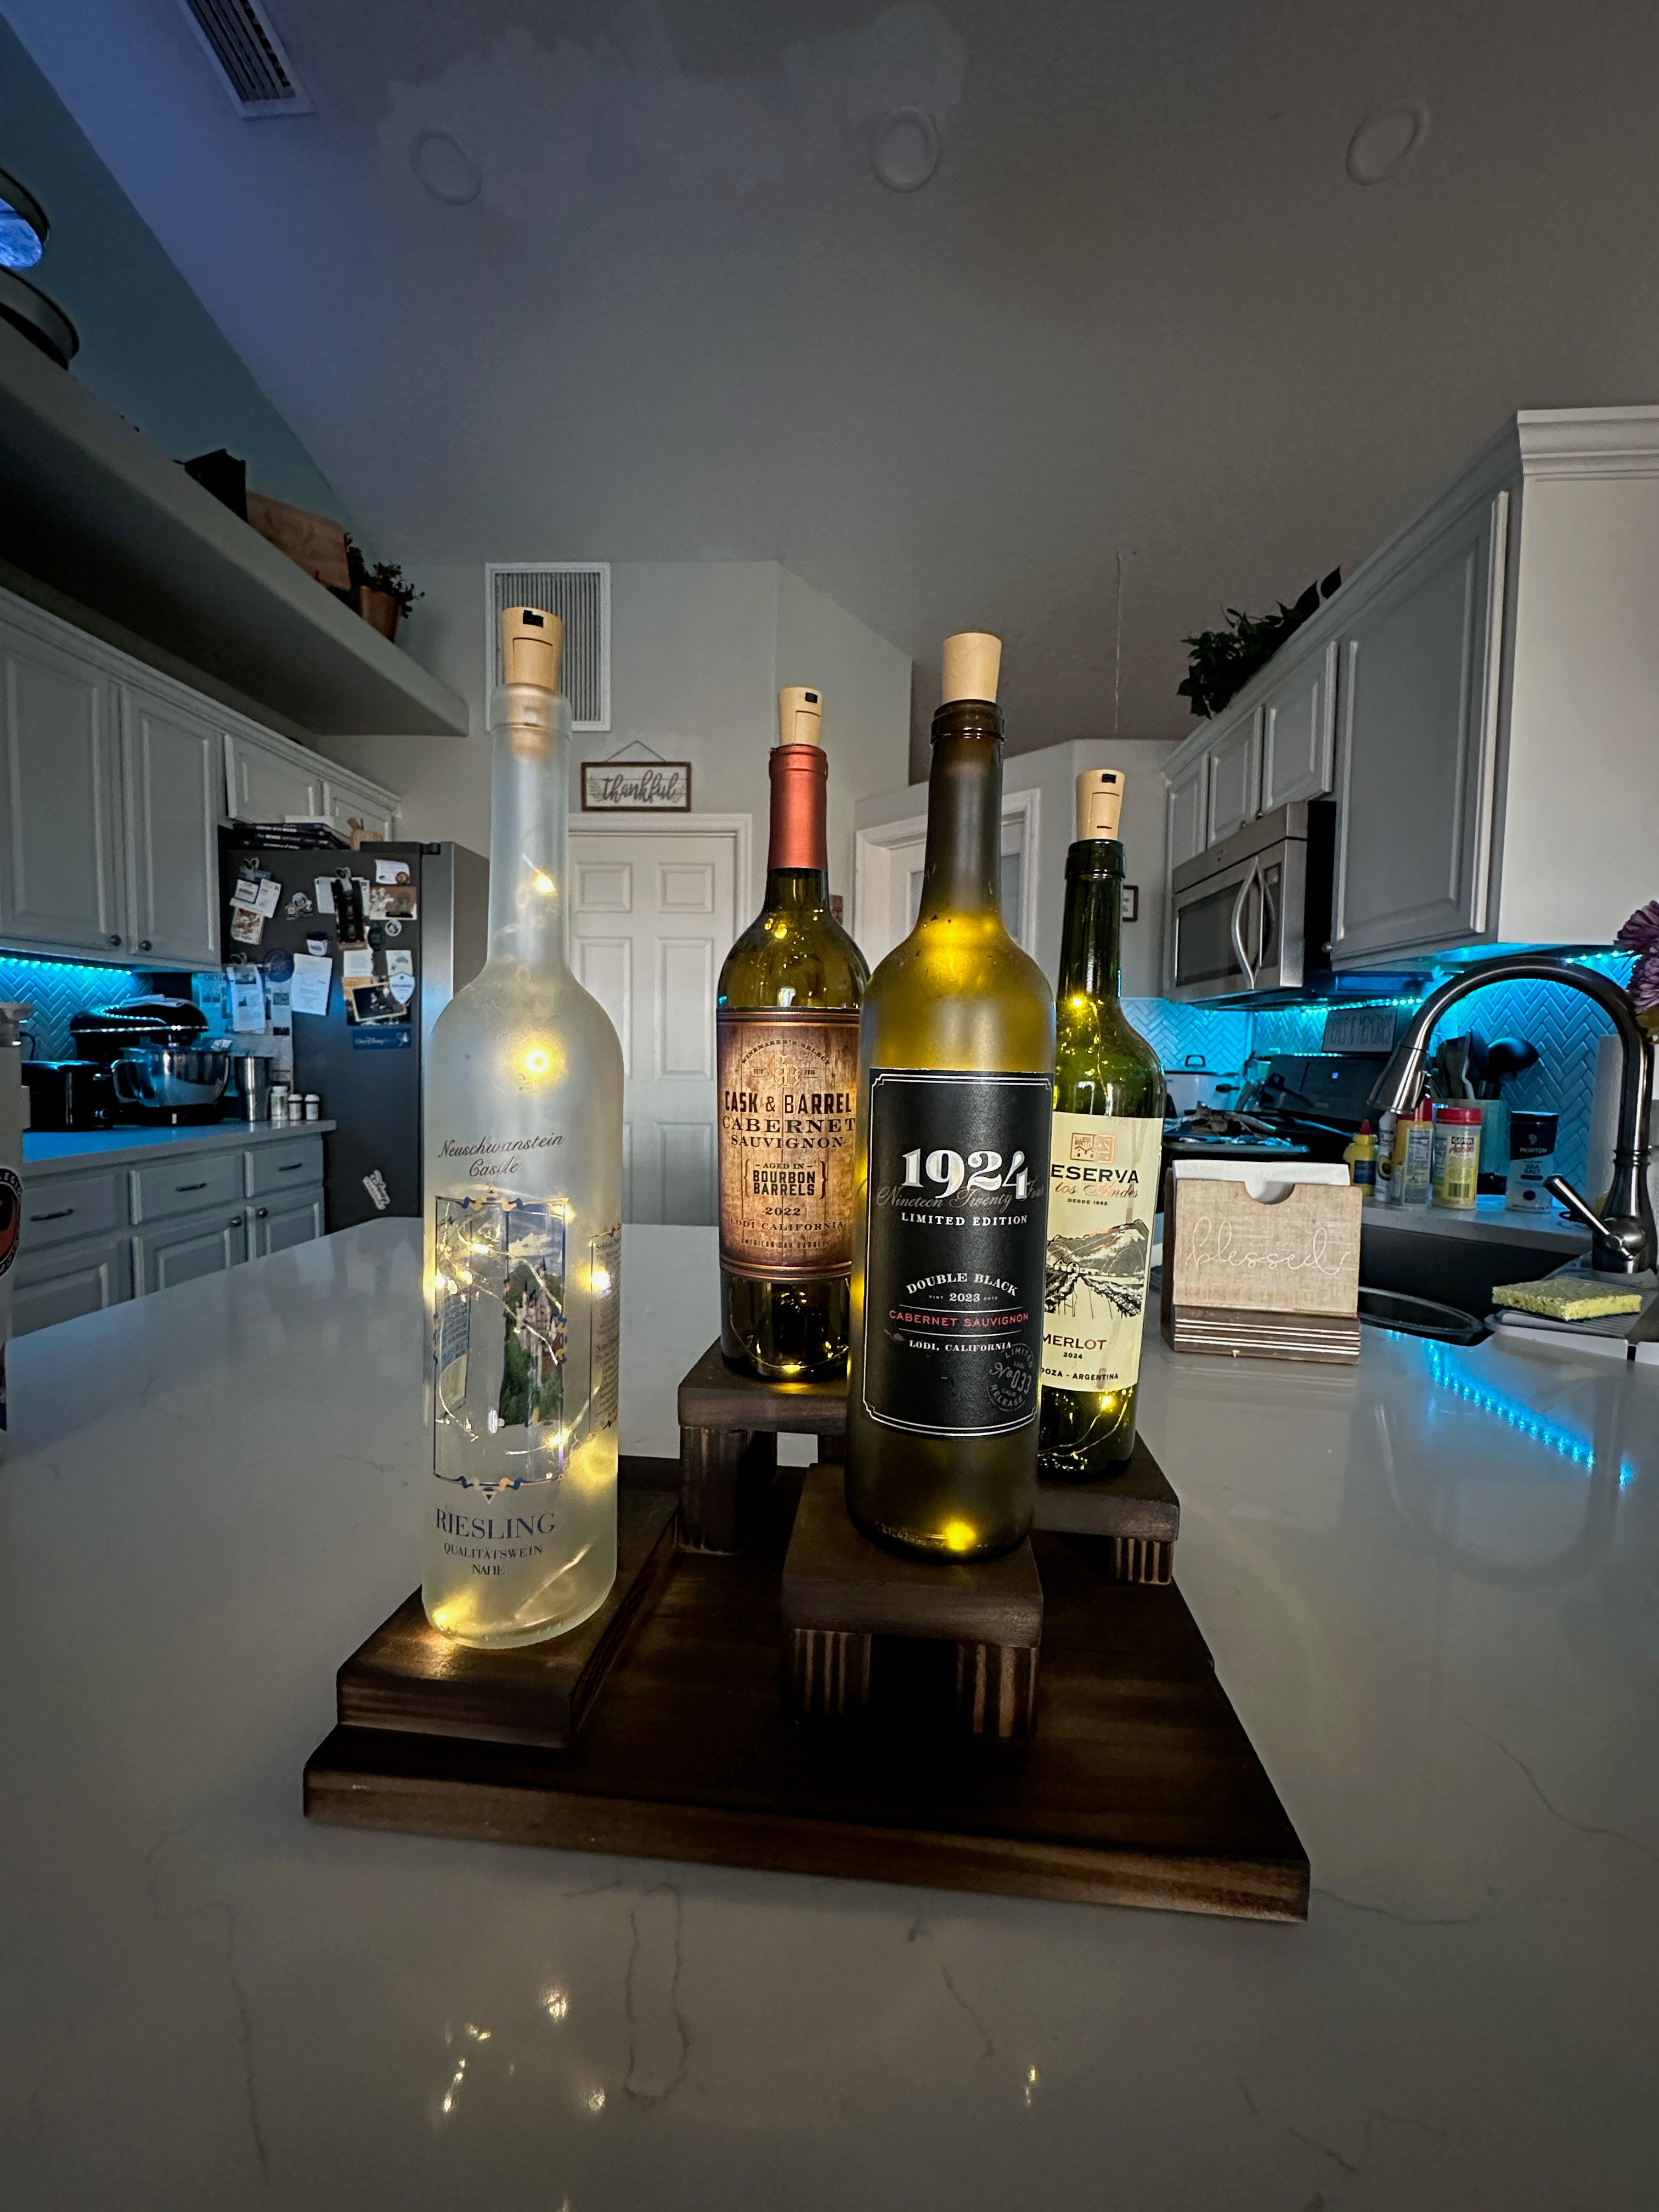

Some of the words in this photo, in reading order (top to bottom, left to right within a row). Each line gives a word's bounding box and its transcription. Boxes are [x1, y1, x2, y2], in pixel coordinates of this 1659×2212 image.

[602, 770, 679, 804] thankful
[741, 1039, 797, 1064] WINEMAKER'S
[801, 1043, 830, 1065] SELECT
[725, 1091, 758, 1113] CASK
[766, 1096, 775, 1112] &
[785, 1093, 851, 1114] BARREL
[723, 1115, 855, 1133] CABERNET
[438, 1132, 565, 1158] Neuschwanstein
[731, 1135, 843, 1149] SAUVIGNON
[469, 1155, 520, 1177] Castle
[901, 1148, 1029, 1199] 1924
[1051, 1164, 1139, 1183] ESERVA
[753, 1170, 815, 1183] BOURBON
[754, 1182, 815, 1195] BARRELS
[1055, 1181, 1076, 1194] los
[1084, 1180, 1138, 1198] Andes
[876, 1186, 943, 1207] Nineteen
[950, 1186, 1014, 1213] Twenty
[765, 1207, 801, 1216] 2022
[901, 1212, 964, 1226] LIMITED
[972, 1215, 1028, 1226] EDITION
[730, 1217, 755, 1228] LODI
[761, 1221, 844, 1231] CALIFORNIA
[741, 1238, 774, 1248] AMERICAN
[1185, 1216, 1351, 1276] blessed
[906, 1273, 967, 1294] DOUBLE
[974, 1273, 1018, 1296] BLACK
[949, 1293, 980, 1302] 2023
[889, 1310, 958, 1327] CABERNET
[964, 1312, 1029, 1327] SAUVIGNON
[909, 1340, 940, 1351] LODI,
[945, 1341, 1011, 1352] CALIFORNIA
[1043, 1334, 1107, 1350] MERLOT
[1005, 1347, 1032, 1368] LIMITED
[1011, 1370, 1032, 1394] 033
[991, 1384, 1023, 1407] RELEASE
[436, 1508, 556, 1539] RIESLING
[444, 1542, 543, 1559] QUALITÄTSWEIN
[472, 1564, 505, 1575] NAHE
